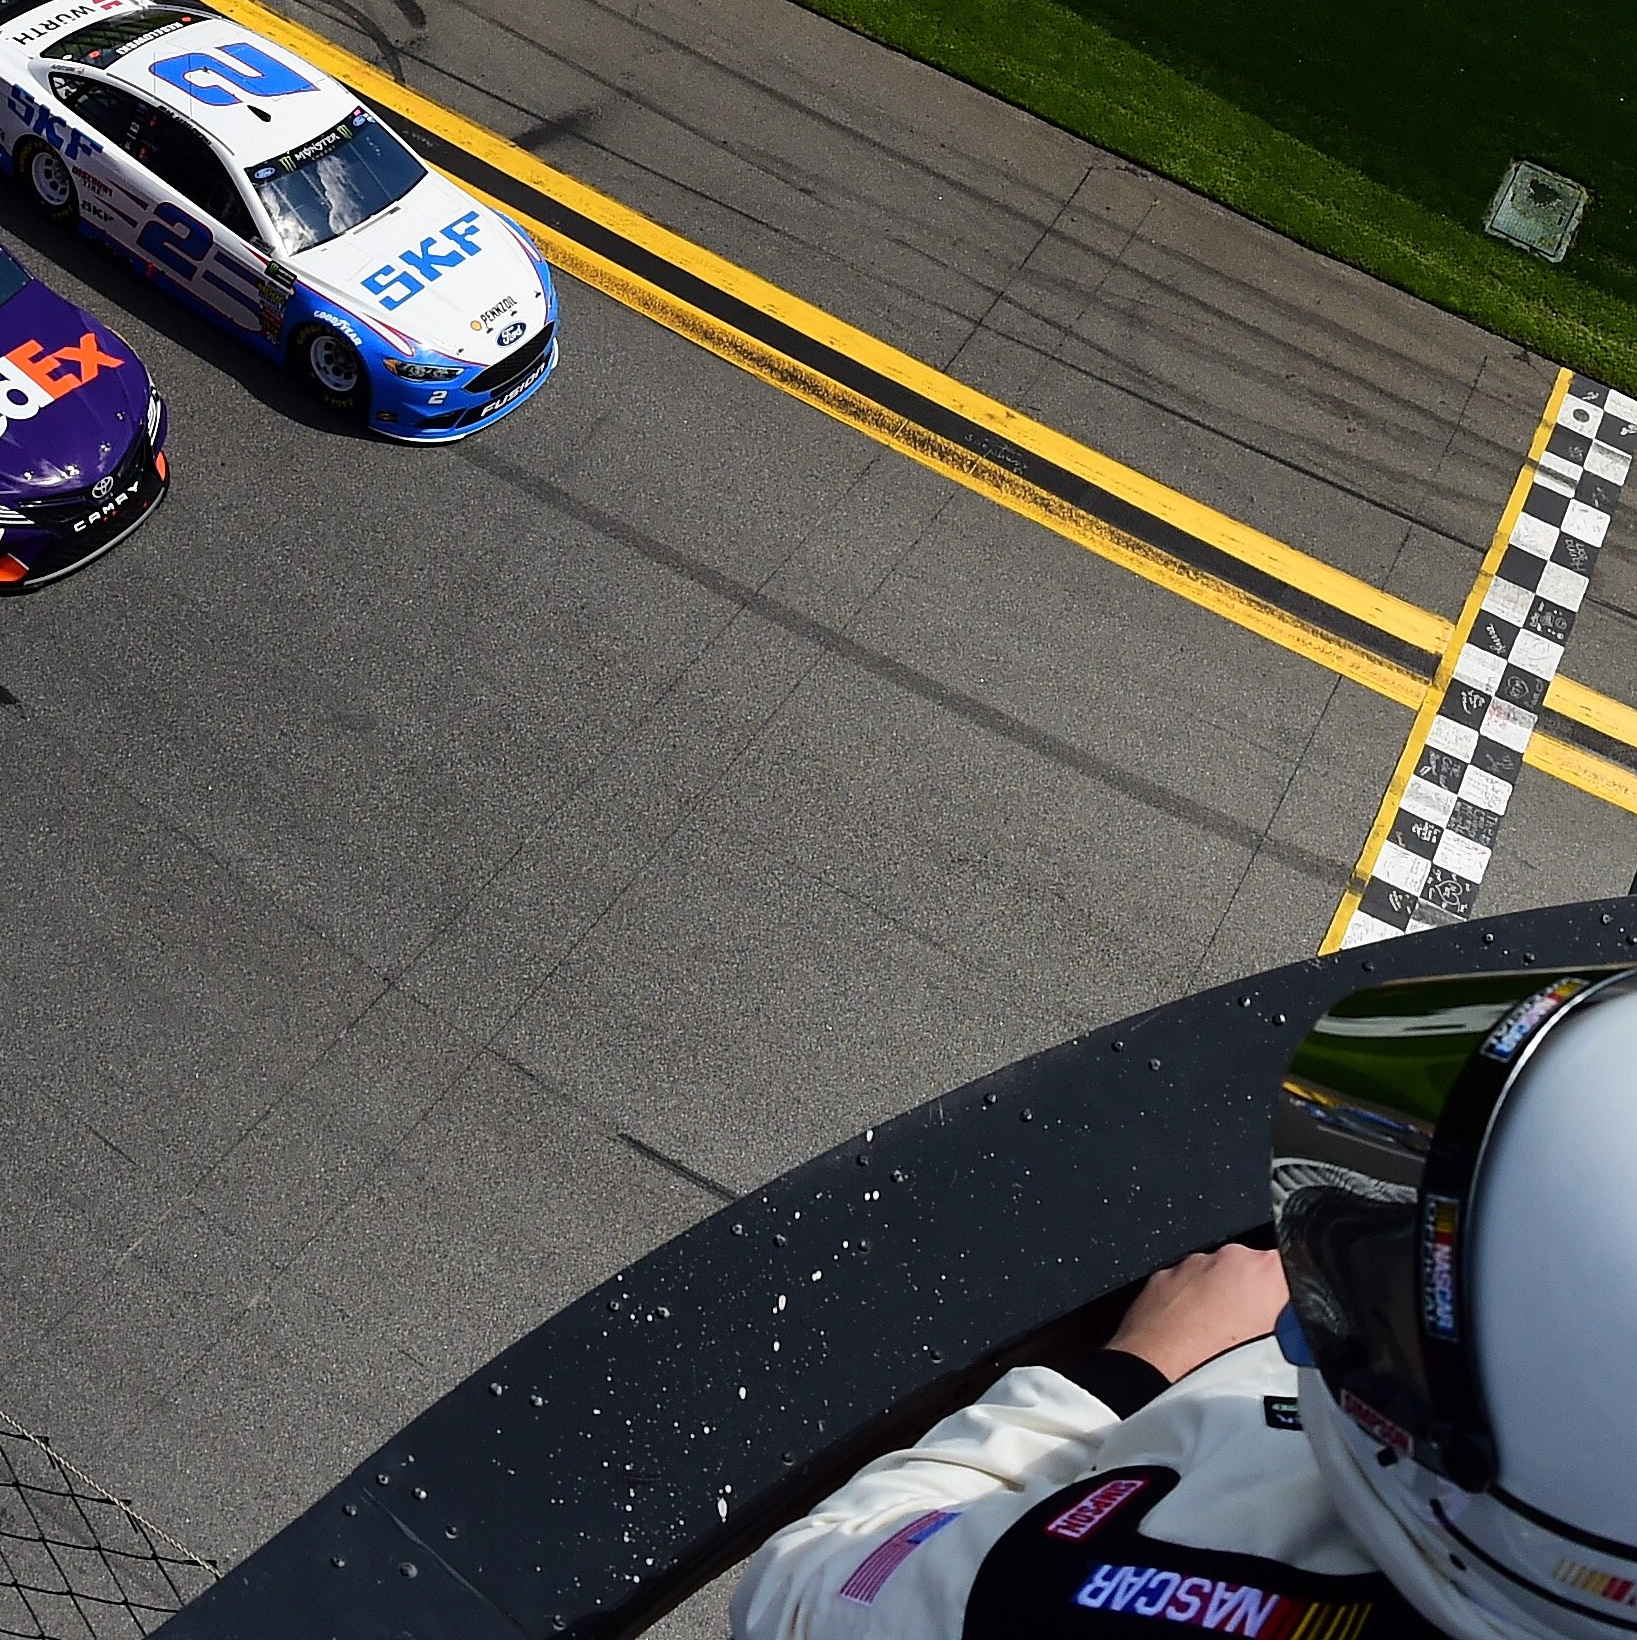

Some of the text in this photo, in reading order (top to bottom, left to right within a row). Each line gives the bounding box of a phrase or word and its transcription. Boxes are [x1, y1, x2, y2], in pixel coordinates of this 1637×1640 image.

[11, 3, 97, 47] WÜRTH
[115, 20, 185, 57] KESELOWSKI
[149, 42, 321, 107] 2
[7, 83, 105, 161] SKF
[293, 132, 341, 163] MONSTER
[71, 164, 114, 197] DISCOUNT
[80, 202, 115, 223] SKF
[136, 201, 215, 282] 2
[360, 210, 483, 312] SKF
[312, 309, 363, 348] GOODYEAR
[479, 295, 519, 327] PENNZOIL
[499, 322, 527, 346] Ford
[426, 390, 448, 406] 2
[480, 361, 547, 418] FUSION
[73, 480, 139, 533] CAMRY
[1055, 1480, 1143, 1538] SIMPSON
[1075, 1564, 1278, 1639] NASCAR
